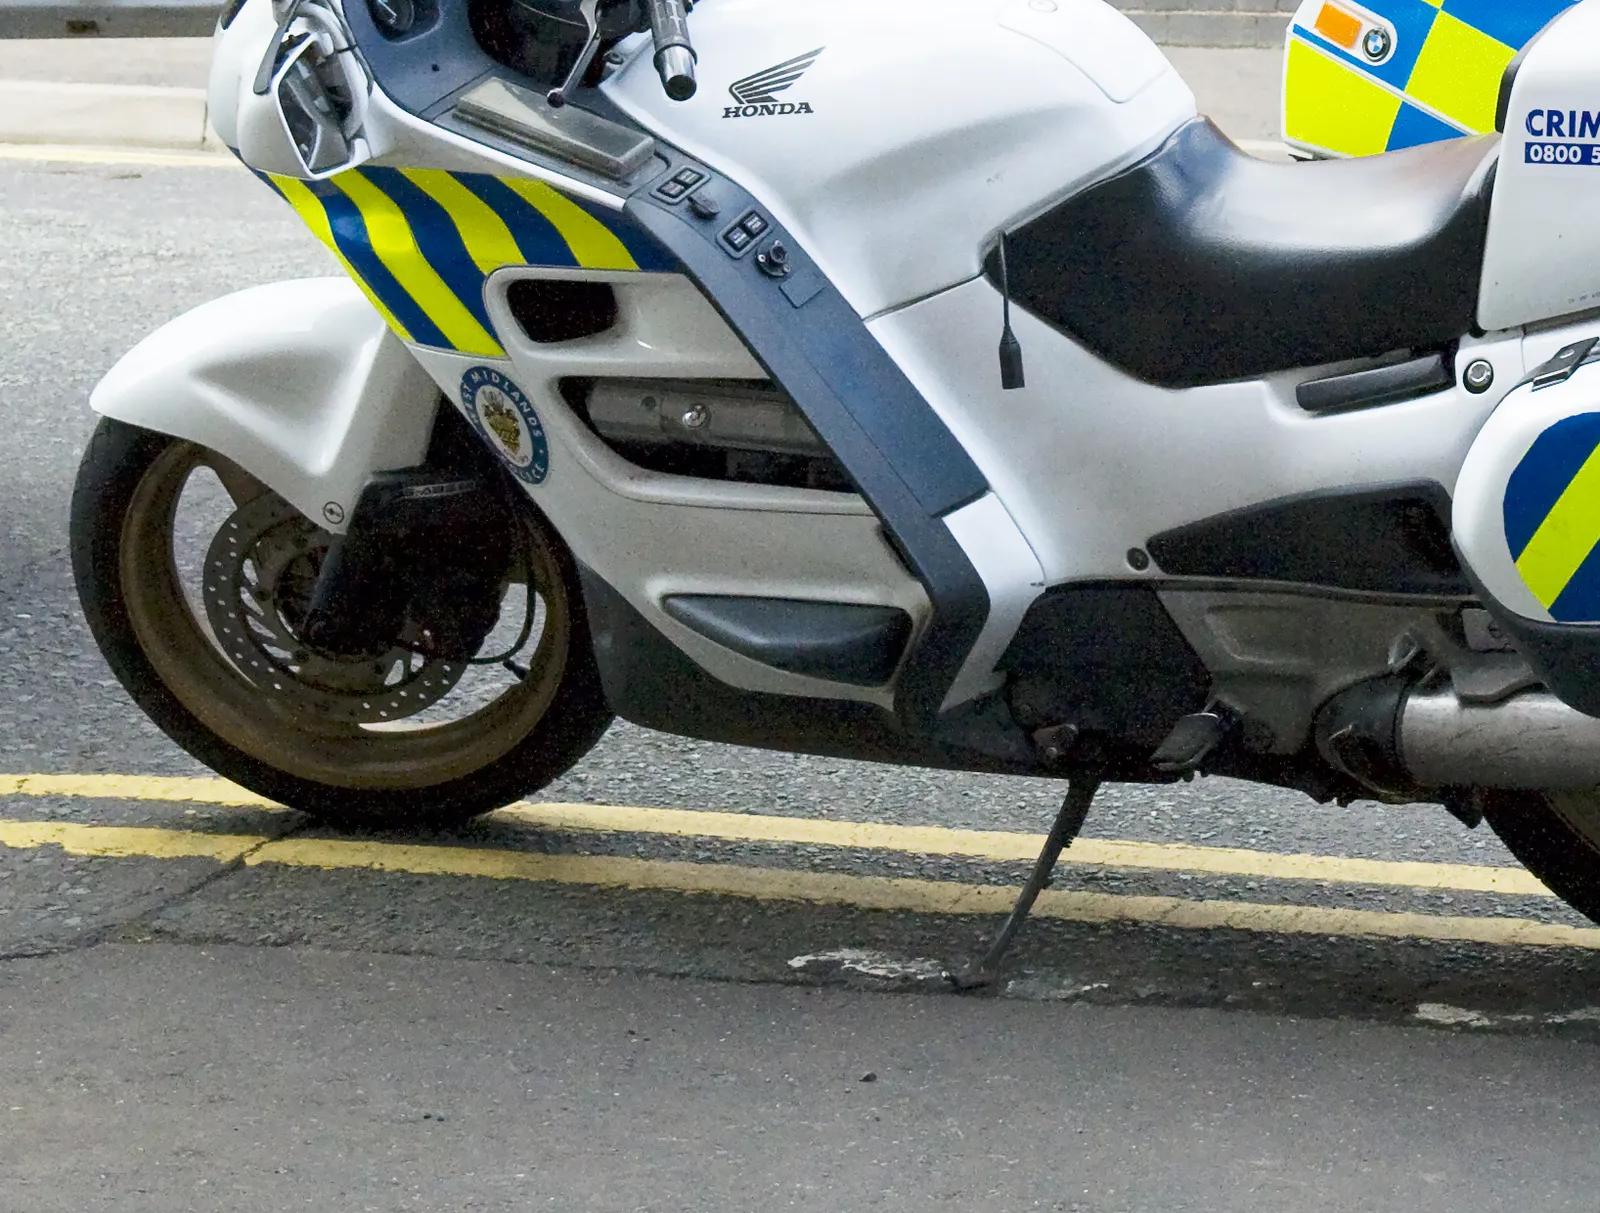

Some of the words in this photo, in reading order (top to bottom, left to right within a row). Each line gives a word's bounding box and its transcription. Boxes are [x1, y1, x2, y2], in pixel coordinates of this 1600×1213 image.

[722, 102, 814, 119] HONDA
[1529, 144, 1582, 164] 0800
[471, 370, 542, 437] MIDLANDS
